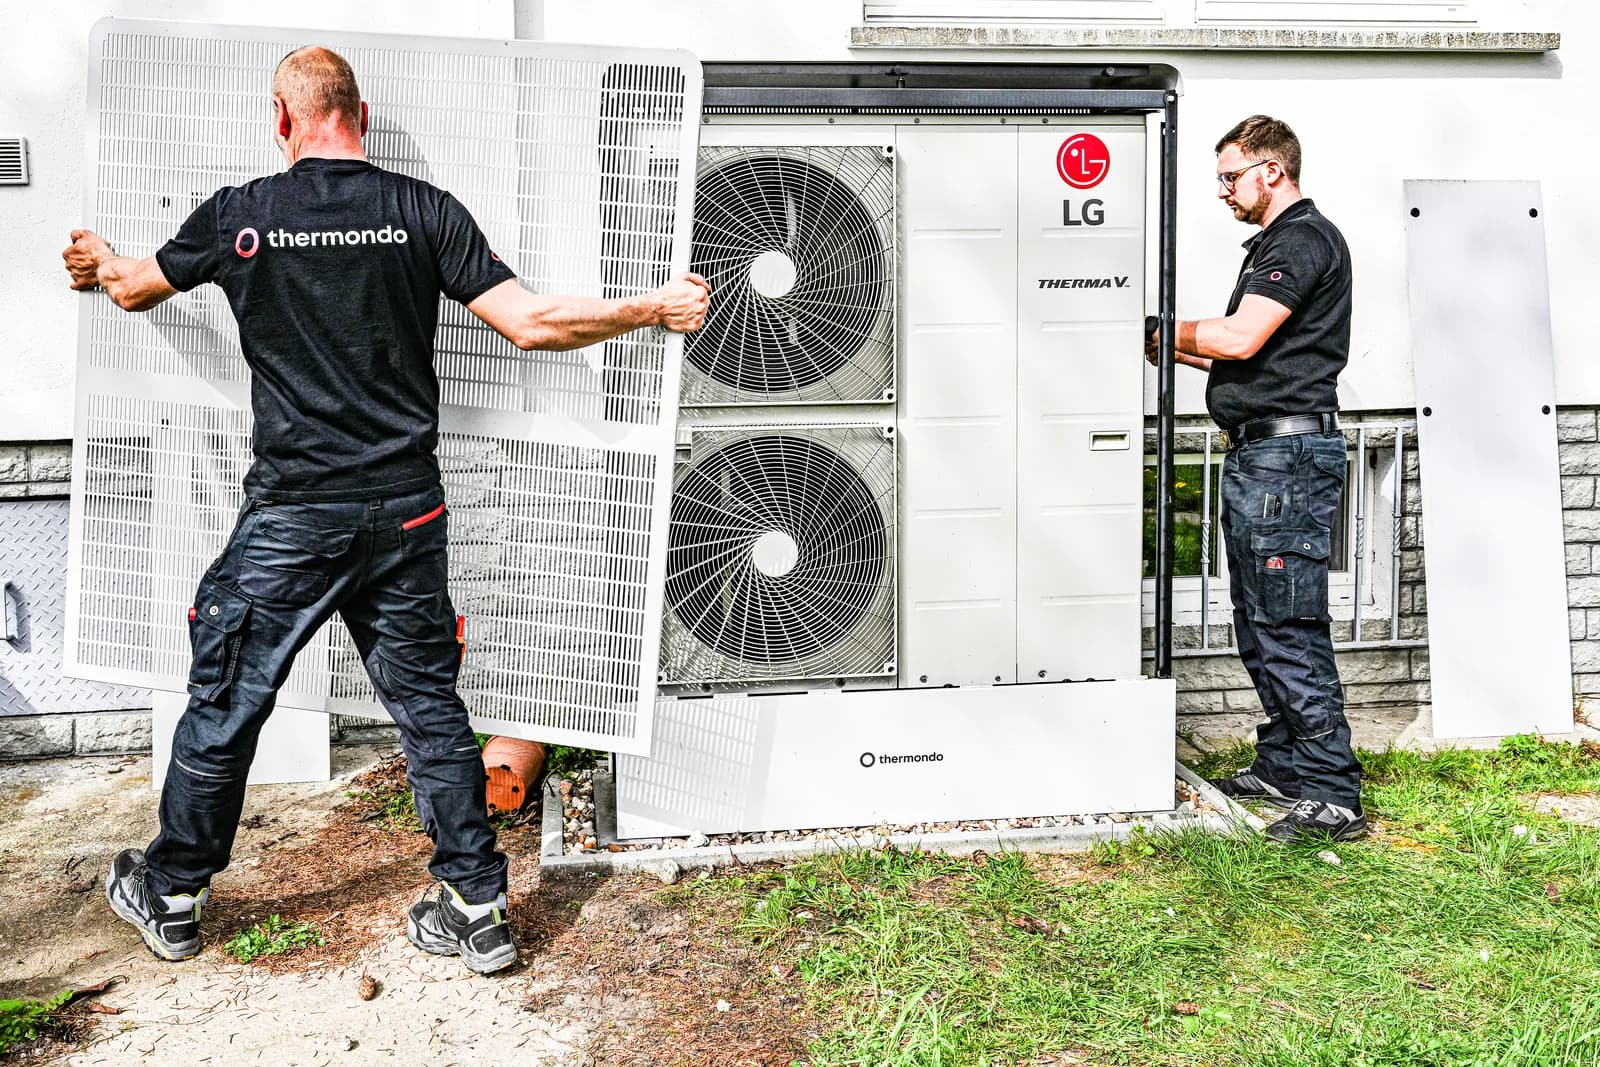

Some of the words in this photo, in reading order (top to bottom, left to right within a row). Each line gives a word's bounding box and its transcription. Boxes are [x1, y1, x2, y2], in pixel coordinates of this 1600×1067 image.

[1063, 198, 1105, 226] LG
[266, 224, 409, 248] thermondo
[1038, 278, 1112, 289] THERMA
[879, 751, 944, 764] thermondo
